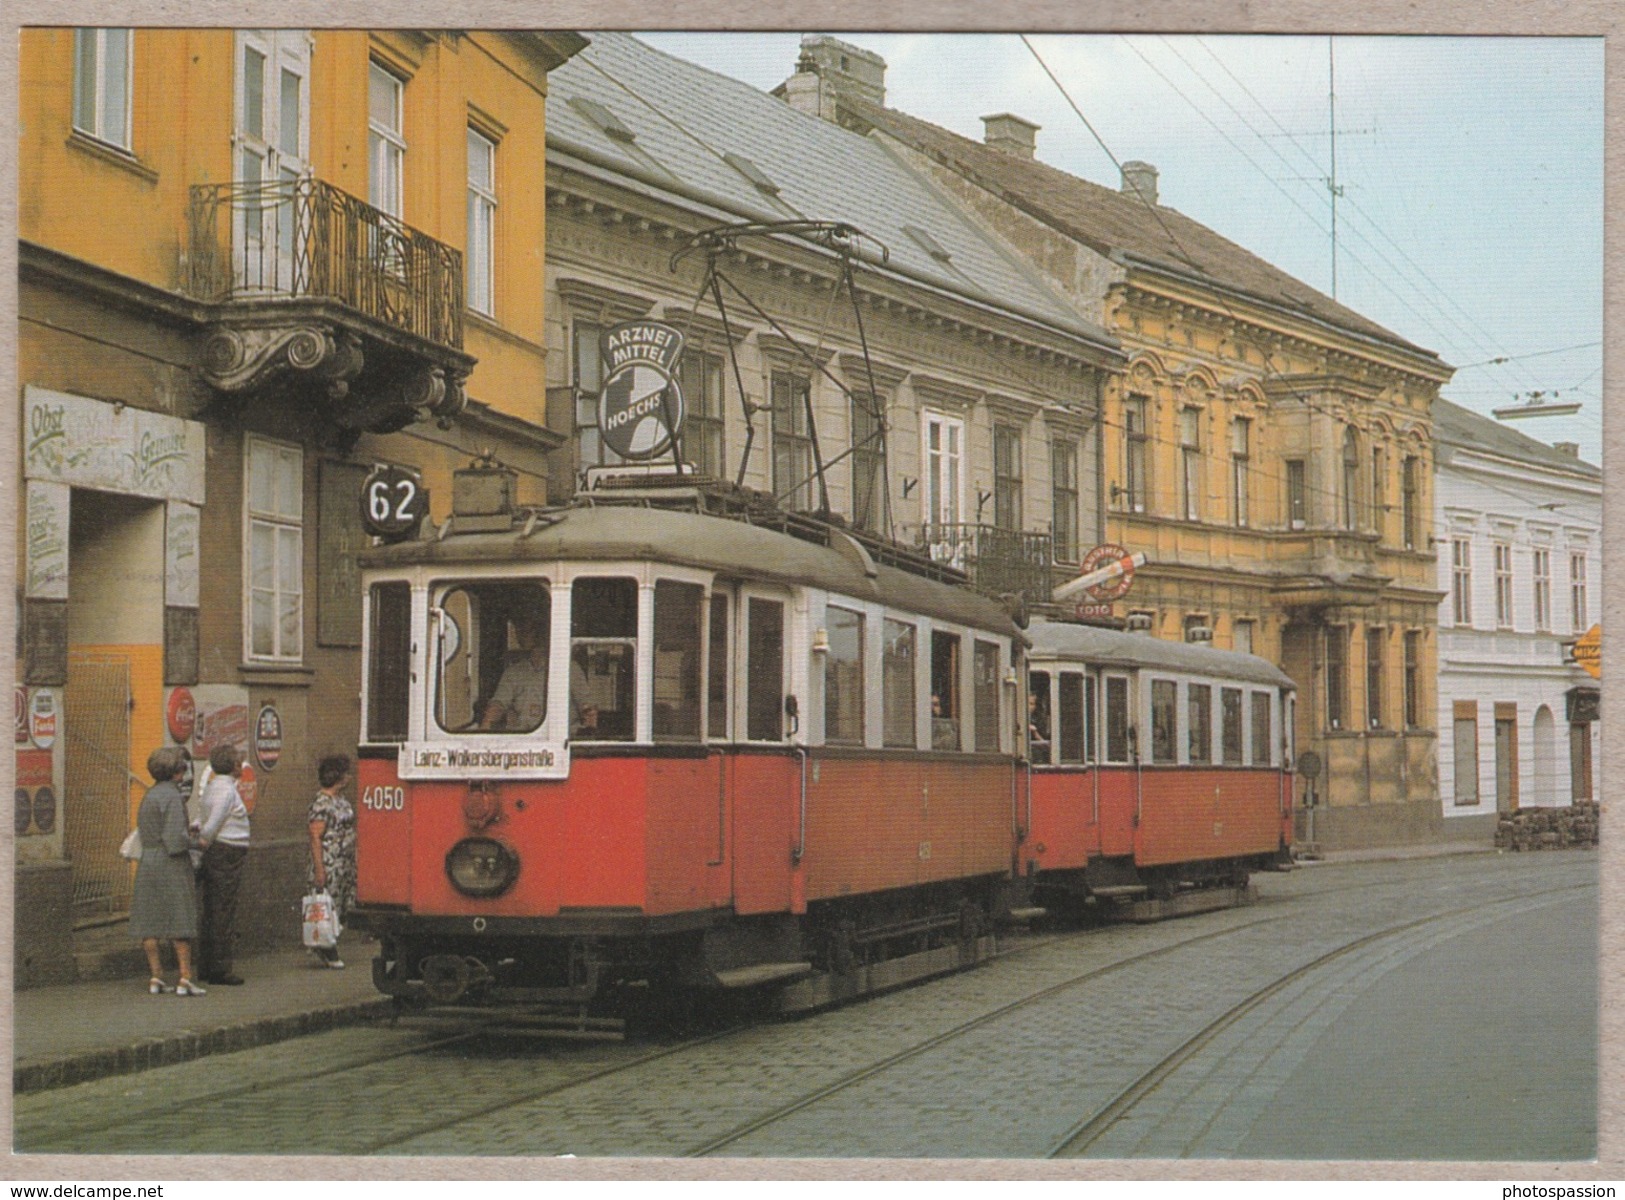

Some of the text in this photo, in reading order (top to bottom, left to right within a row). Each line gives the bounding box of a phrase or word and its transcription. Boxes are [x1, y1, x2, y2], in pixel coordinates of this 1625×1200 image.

[608, 327, 672, 349] ARZNEI
[613, 344, 666, 366] MITTEL
[31, 403, 65, 438] Obst
[607, 391, 666, 431] HOECHS
[370, 480, 415, 521] 62
[362, 786, 404, 810] 4050
